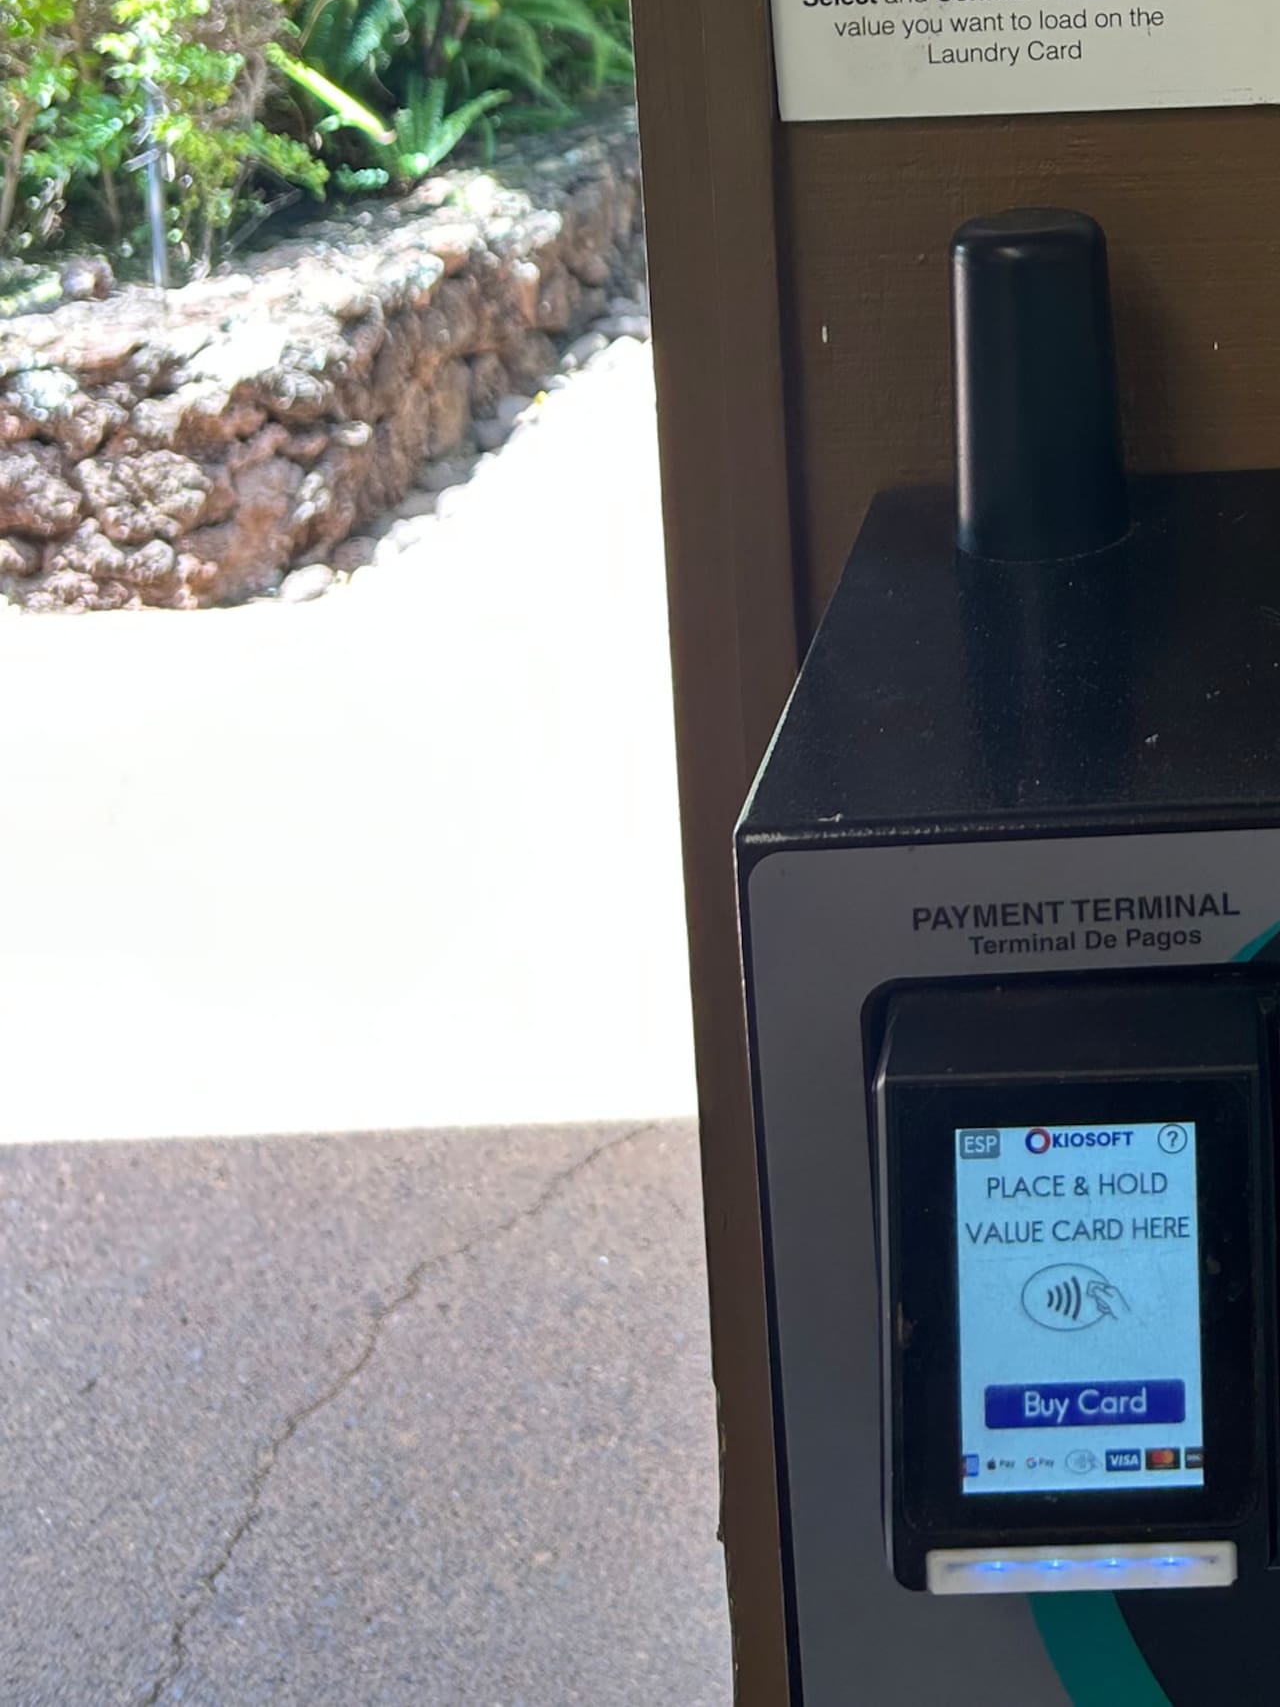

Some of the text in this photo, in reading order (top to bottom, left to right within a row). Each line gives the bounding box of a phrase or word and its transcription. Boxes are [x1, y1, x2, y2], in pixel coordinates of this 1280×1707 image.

[928, 39, 1082, 67] Laundry Card
[912, 892, 1241, 932] PAYMENT TERMINAL
[968, 926, 1202, 956] Terminal De Pagos
[963, 1135, 998, 1154] ESP
[986, 1171, 1168, 1198] PLACE & HOLD
[965, 1216, 1191, 1244] VALUE CARD HERE
[1023, 1389, 1147, 1421] Buy Card
